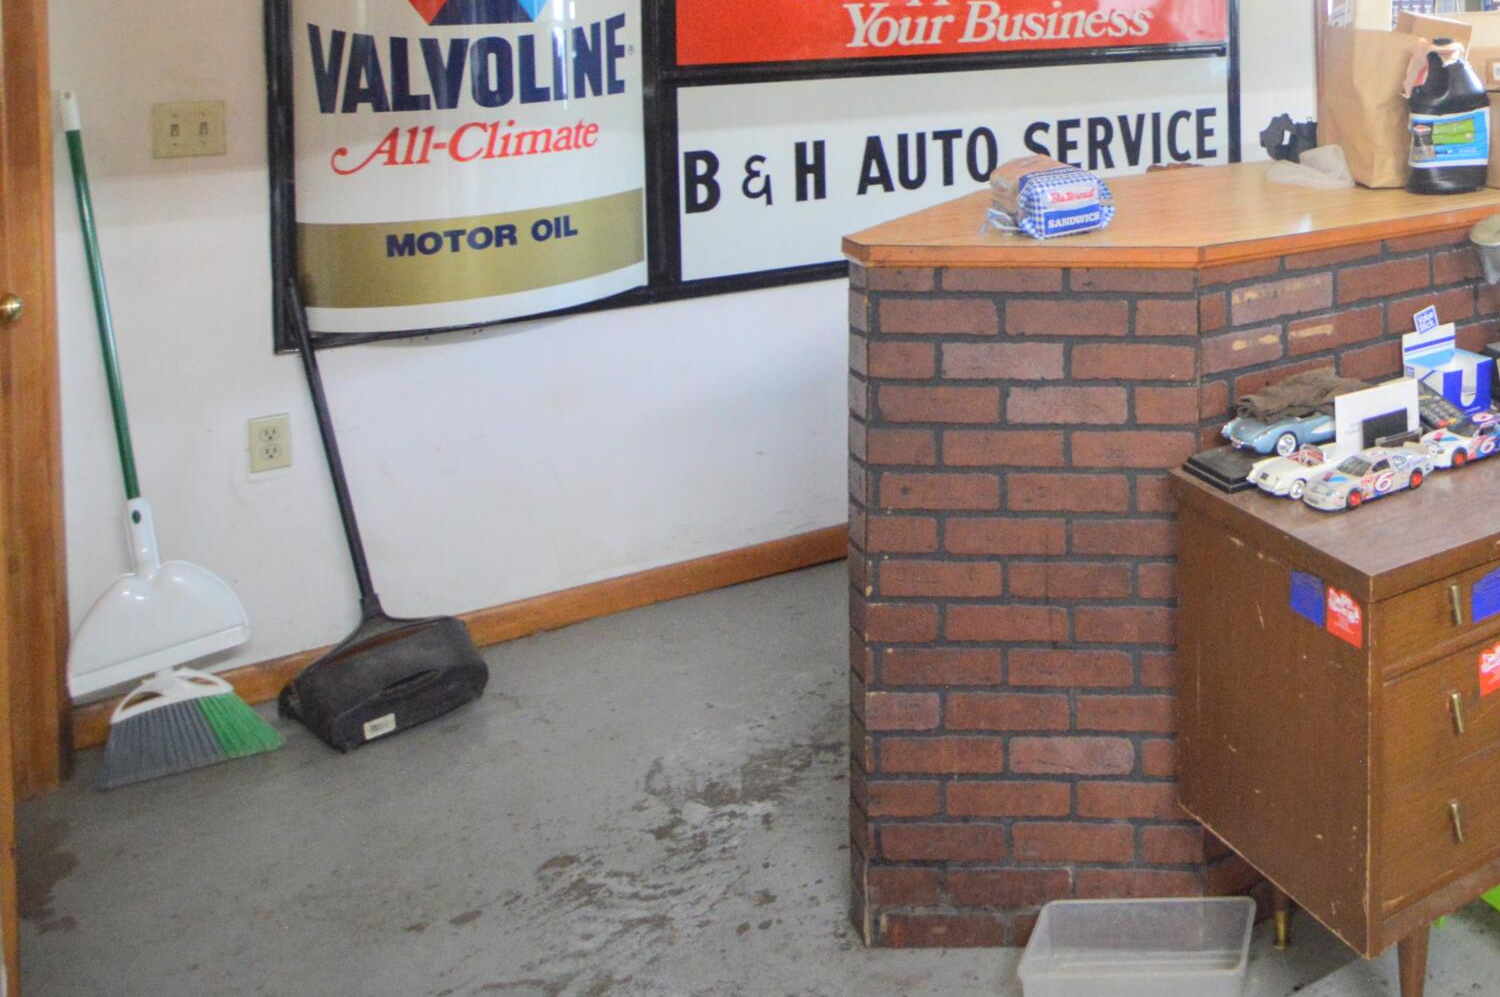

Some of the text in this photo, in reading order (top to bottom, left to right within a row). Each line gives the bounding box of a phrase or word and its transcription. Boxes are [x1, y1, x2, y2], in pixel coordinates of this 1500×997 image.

[843, 0, 1153, 48] Your Business
[307, 13, 625, 115] VALVOLINE
[331, 119, 599, 175] All-Climate
[683, 107, 1217, 214] B & H AUTO SERVICE
[386, 215, 578, 258] MOTOR OIL
[1048, 211, 1101, 228] SANDWICH
[1480, 437, 1495, 453] 6
[1375, 472, 1395, 492] 6
